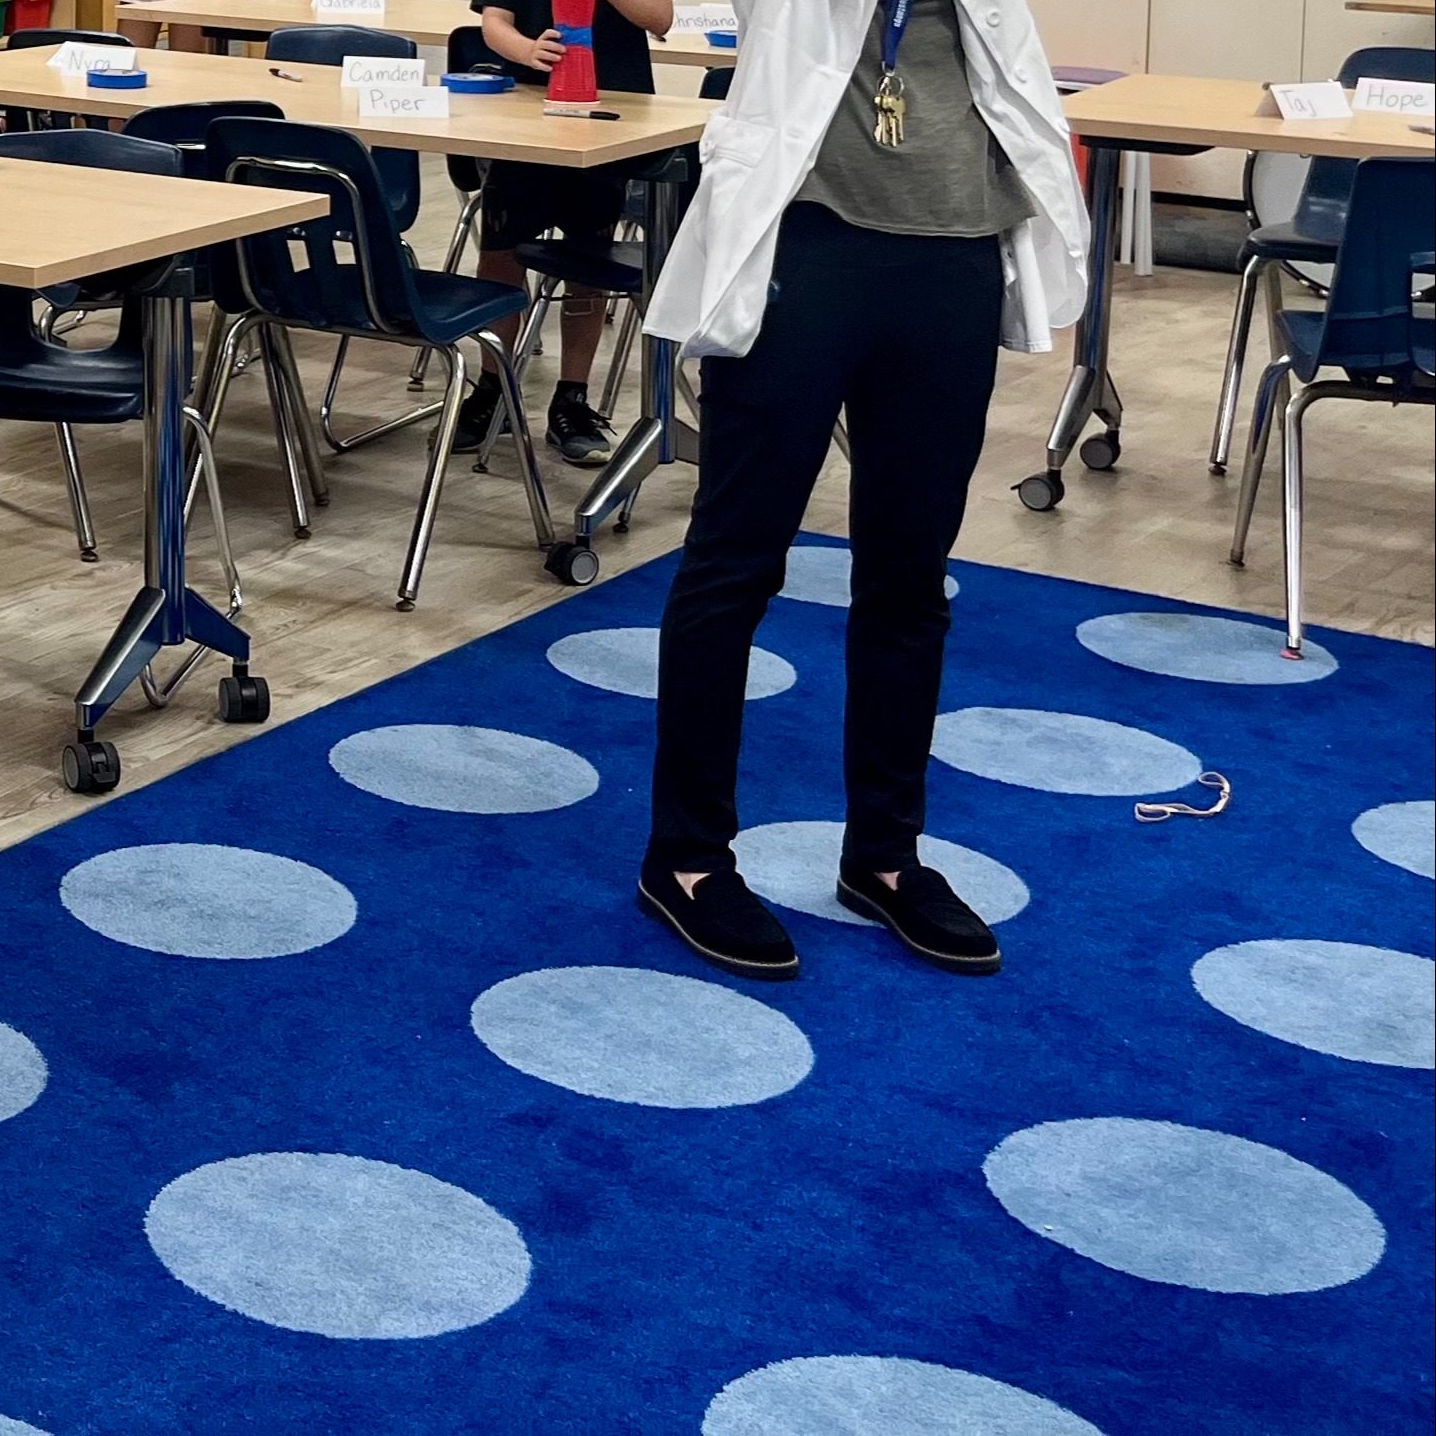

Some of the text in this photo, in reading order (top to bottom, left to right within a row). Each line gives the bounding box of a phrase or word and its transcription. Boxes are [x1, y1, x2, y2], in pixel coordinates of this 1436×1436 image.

[349, 61, 419, 82] Camden
[369, 89, 425, 114] Piper
[1279, 89, 1316, 117] Taj
[1366, 83, 1428, 112] Hope
